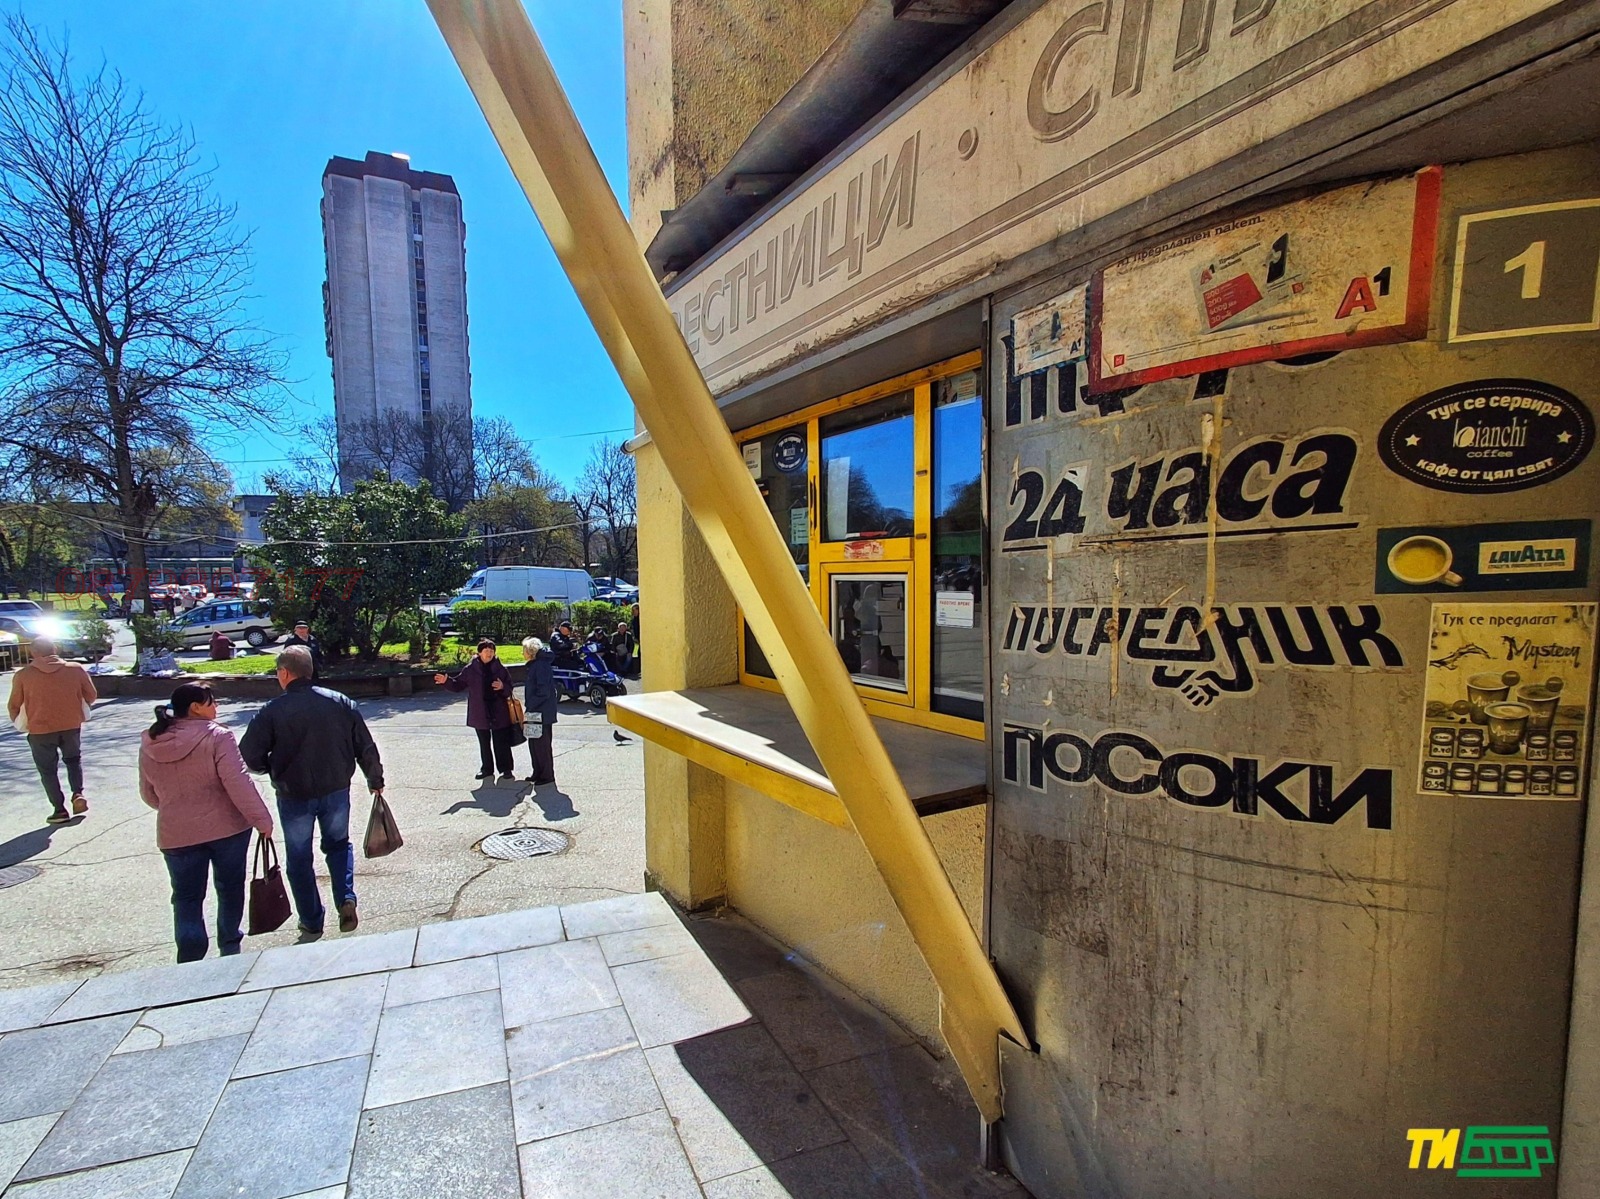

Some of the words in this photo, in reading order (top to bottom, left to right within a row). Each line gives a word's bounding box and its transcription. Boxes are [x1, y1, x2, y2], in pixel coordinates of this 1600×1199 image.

[671, 129, 921, 357] ЕСТНИЦИ
[1503, 240, 1546, 299] 1
[1335, 266, 1392, 319] A1
[1464, 397, 1486, 411] се
[1488, 395, 1564, 418] сервира
[1416, 458, 1459, 477] кафе
[1460, 470, 1481, 480] от
[1483, 468, 1515, 482] цял
[1517, 456, 1555, 476] свят
[1466, 449, 1514, 459] coffee
[1003, 466, 1088, 542] 24
[1107, 433, 1359, 531] часа
[1489, 545, 1566, 563] LAVAZZA
[1441, 613, 1465, 628] Тук
[1469, 615, 1485, 625] се
[1489, 614, 1558, 628] предлагат
[1003, 604, 1405, 690] ПОСРЕДНИК
[1500, 635, 1581, 669] Mystery
[1003, 722, 1392, 831] ПОСОКИ
